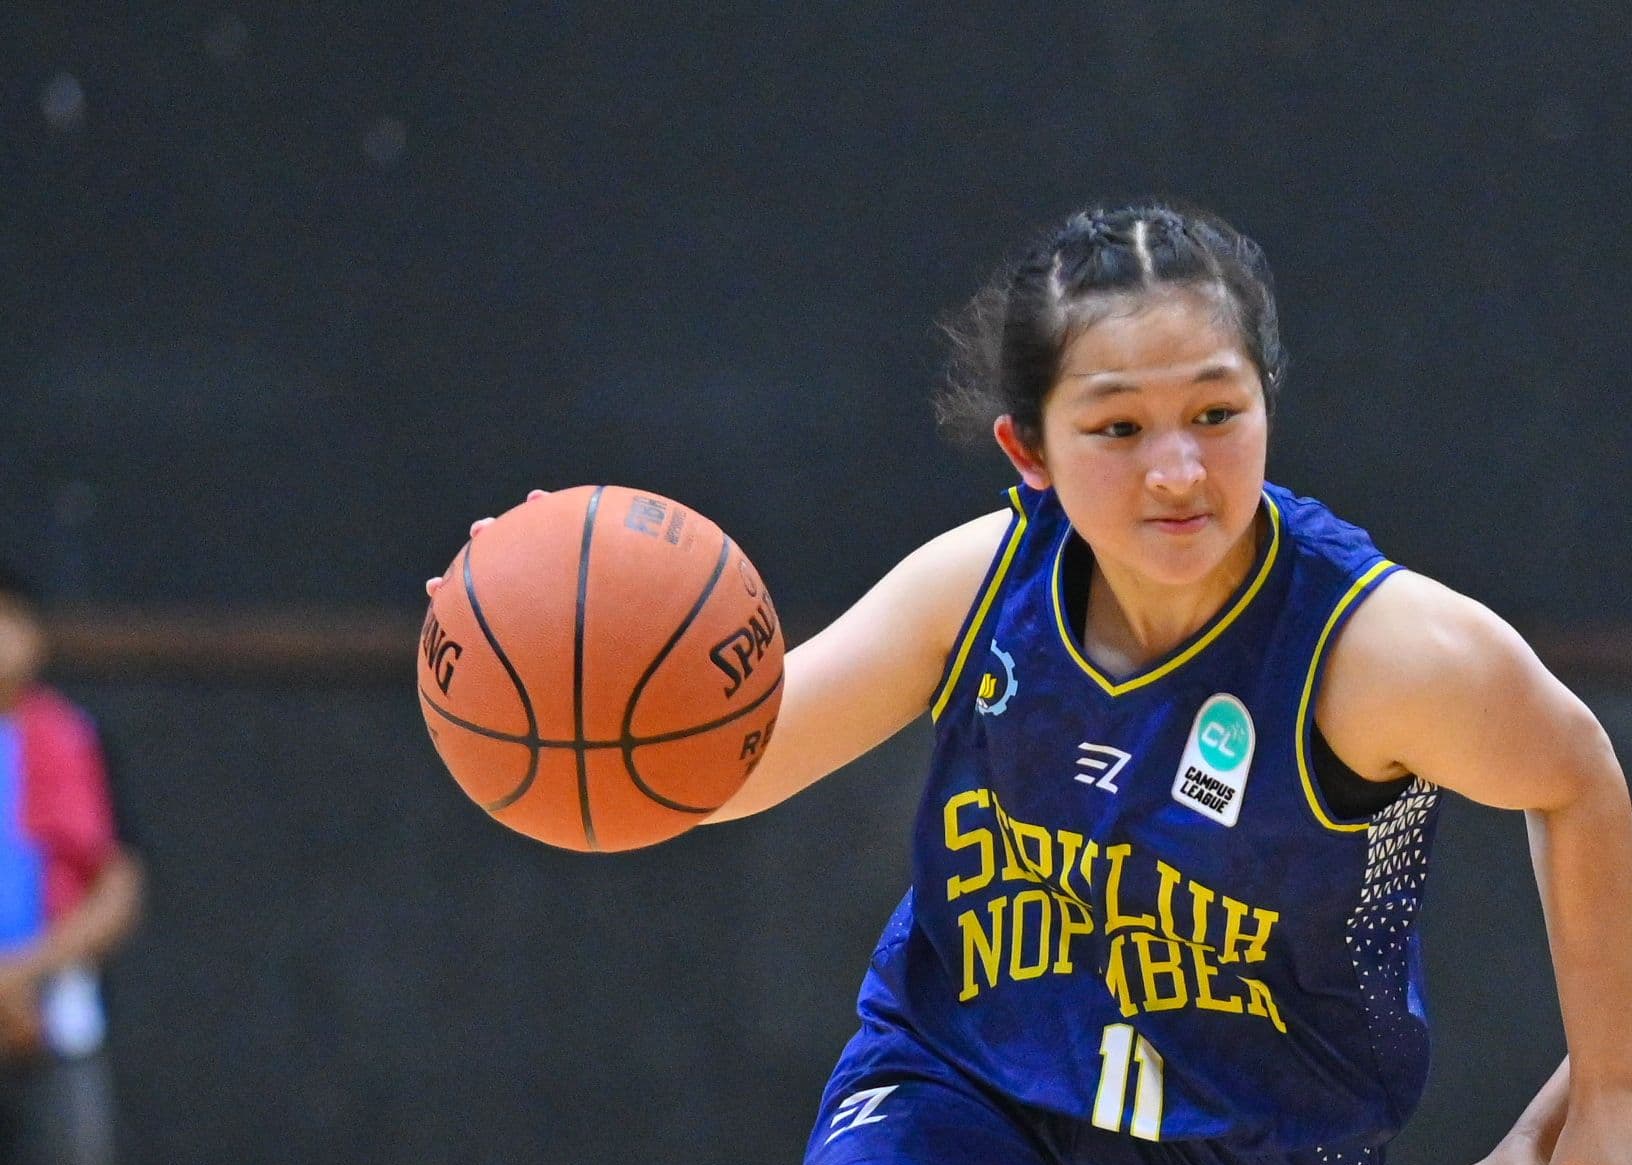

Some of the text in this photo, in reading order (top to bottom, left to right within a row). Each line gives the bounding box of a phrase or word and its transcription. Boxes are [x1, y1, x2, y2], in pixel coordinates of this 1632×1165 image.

[1180, 781, 1228, 814] LEAGUE
[1184, 766, 1236, 801] CAMPUS
[1091, 1023, 1164, 1142] 11
